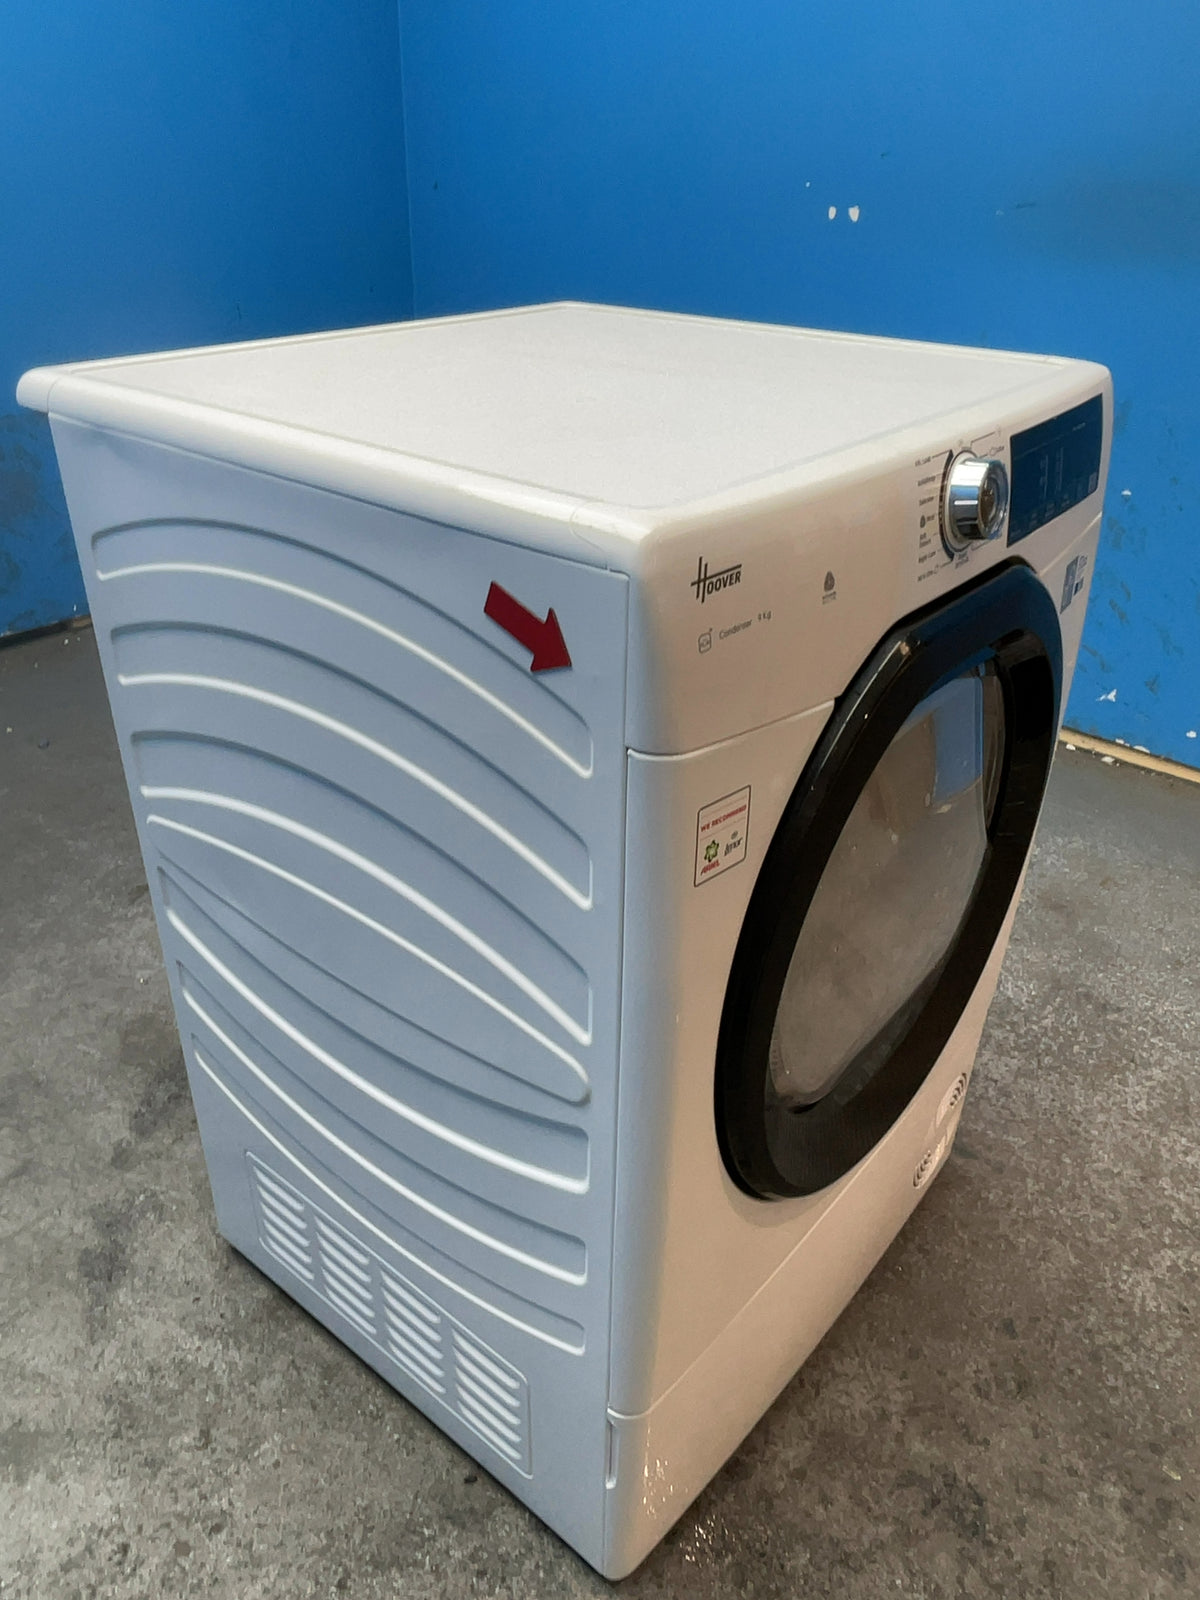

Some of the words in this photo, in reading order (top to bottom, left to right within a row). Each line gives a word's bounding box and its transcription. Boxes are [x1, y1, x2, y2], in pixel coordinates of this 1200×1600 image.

[691, 556, 742, 604] HOOVER
[701, 822, 711, 832] WE
[711, 804, 747, 828] RECOMMEND
